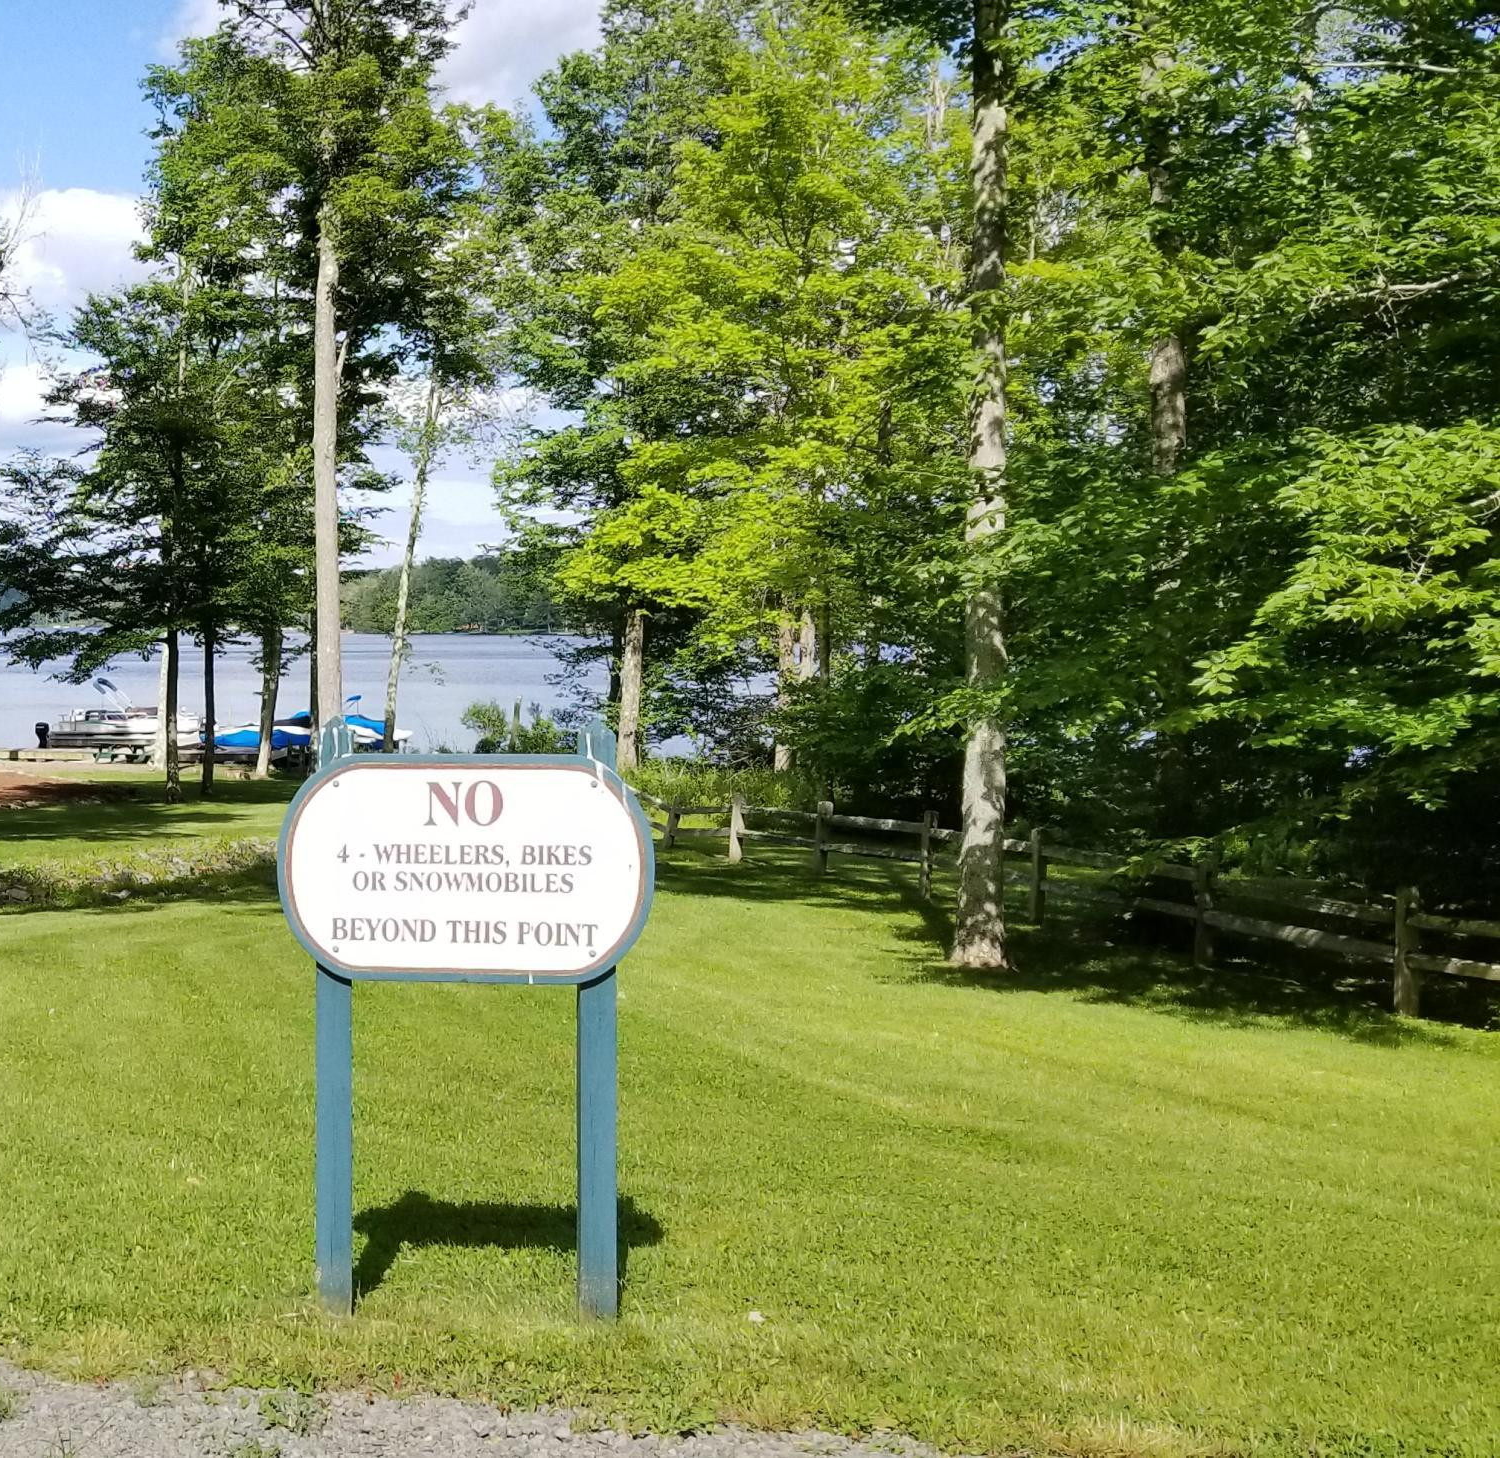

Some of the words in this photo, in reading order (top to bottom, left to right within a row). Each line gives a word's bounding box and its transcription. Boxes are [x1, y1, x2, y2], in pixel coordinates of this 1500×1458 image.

[423, 780, 504, 827] NO
[336, 843, 350, 864] 4
[373, 843, 510, 868] WHEELERS,
[520, 844, 593, 866] BIKES
[352, 870, 387, 892] OR
[393, 870, 574, 894] SNOWMOBILES
[331, 917, 437, 943] BEYOND
[446, 919, 507, 945] THIS
[517, 921, 599, 948] POINT
